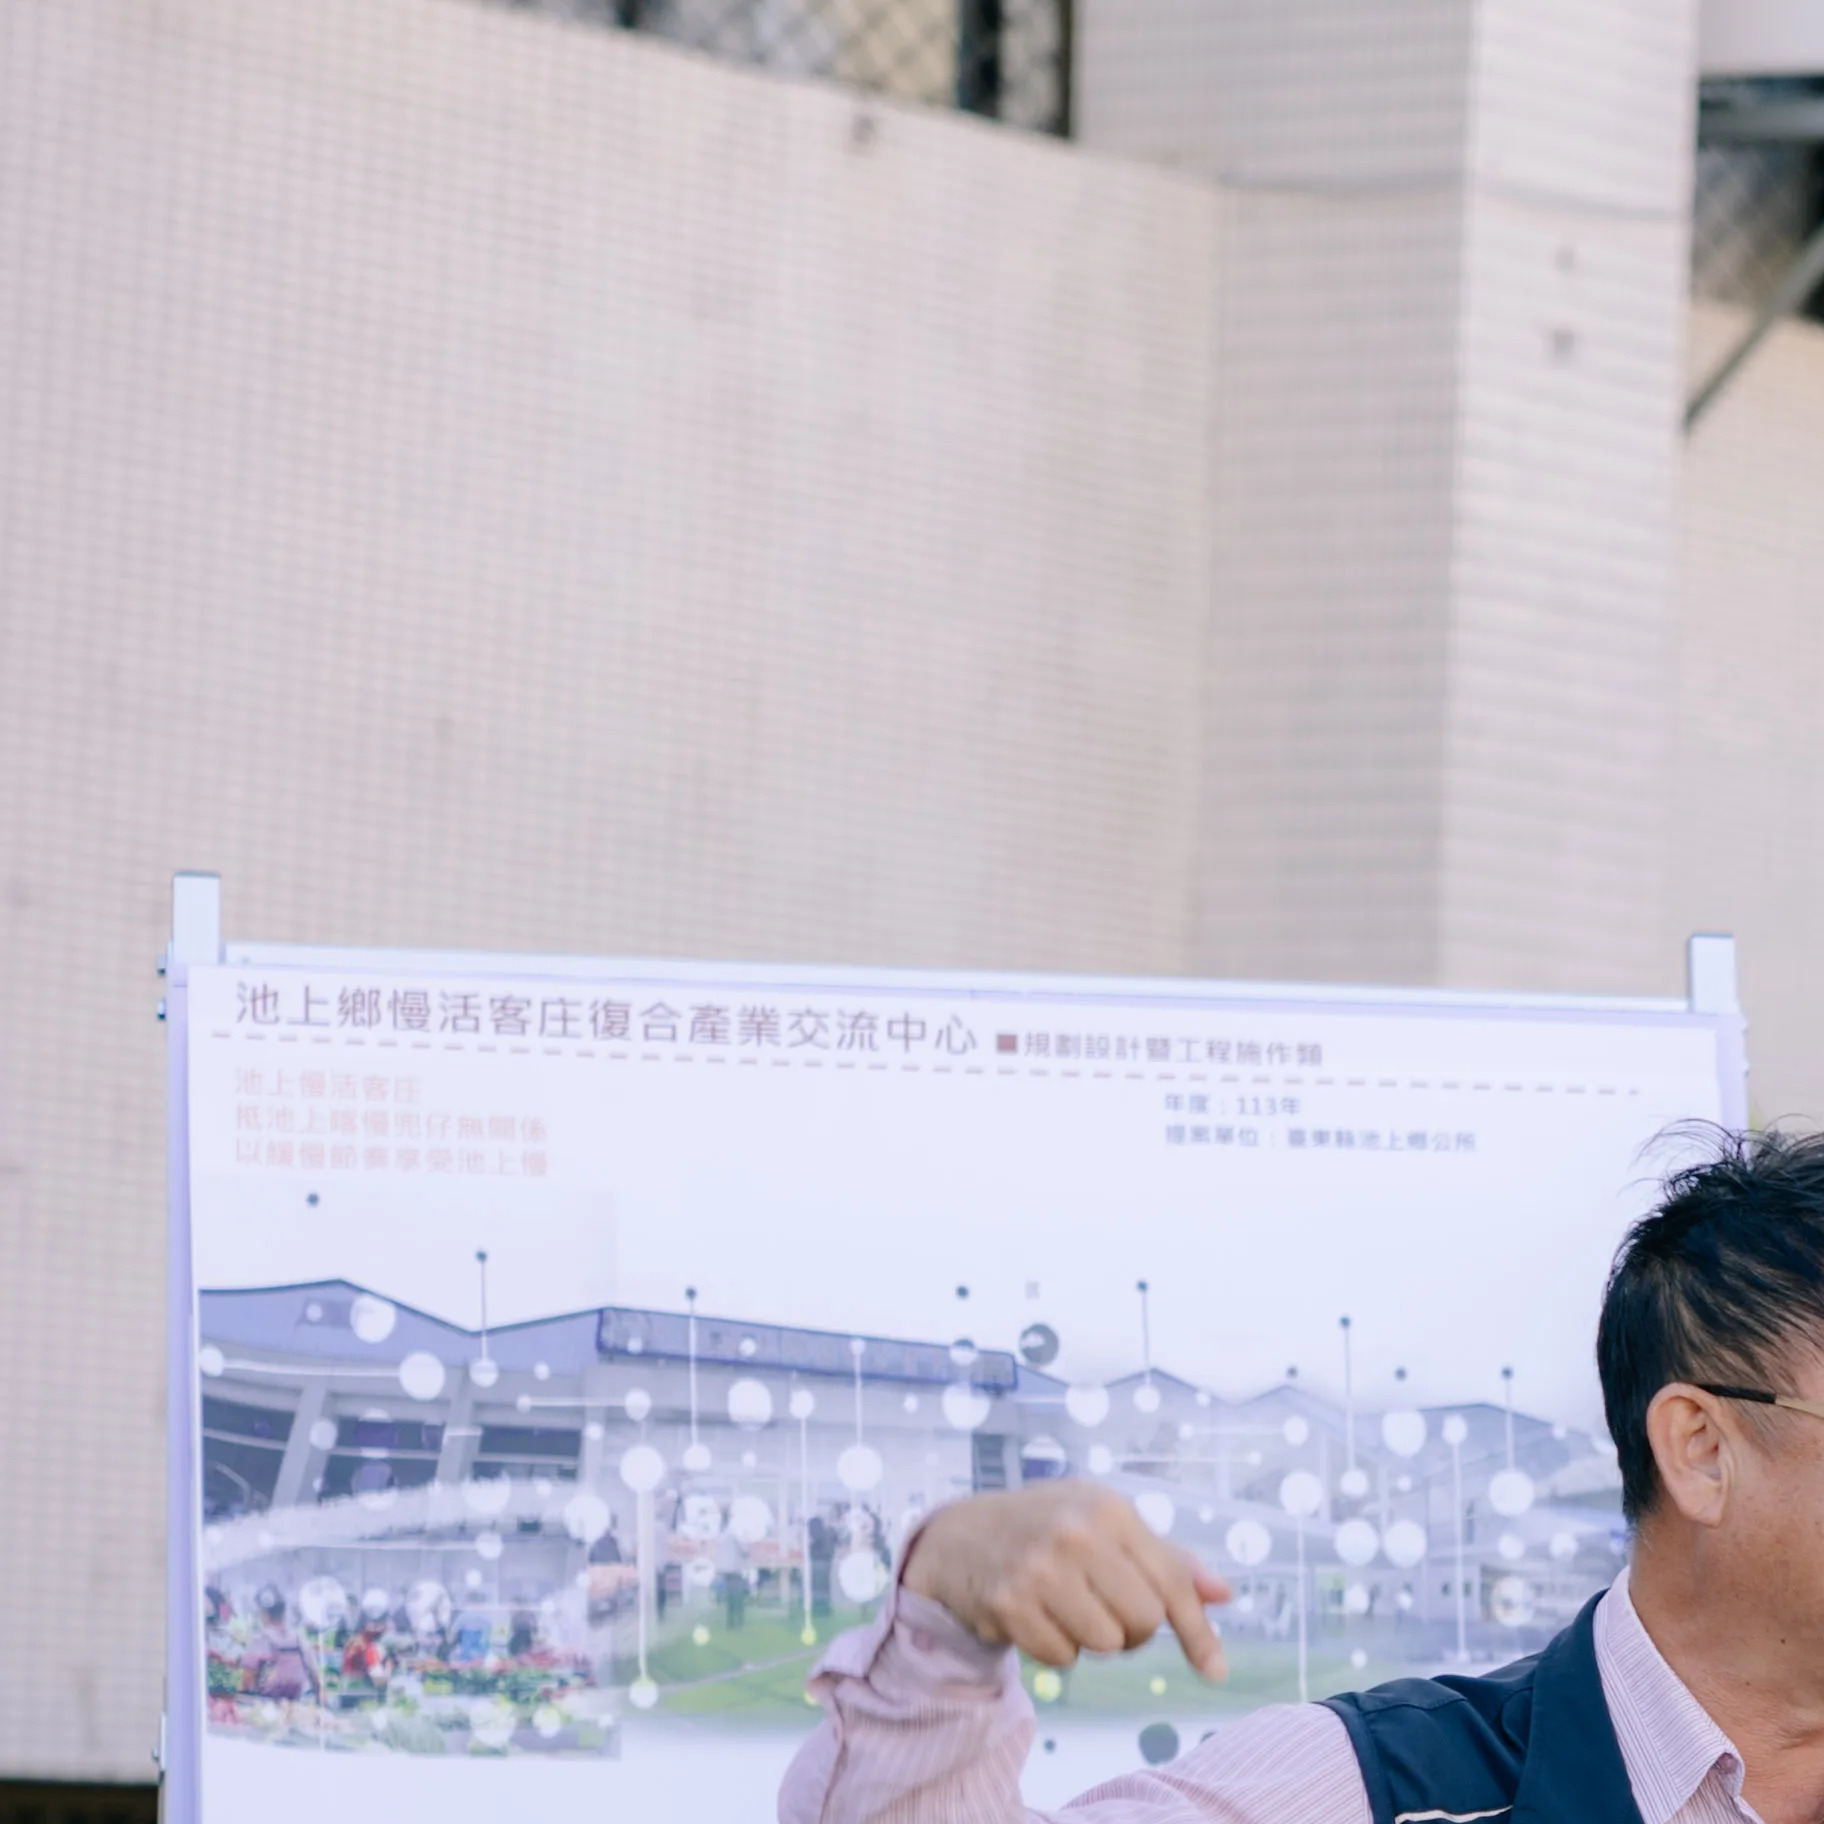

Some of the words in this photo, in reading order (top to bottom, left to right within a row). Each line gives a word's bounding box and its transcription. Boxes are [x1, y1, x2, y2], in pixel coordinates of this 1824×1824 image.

[236, 980, 978, 1055] 池上鄉慢活客庄復合產業交流中心
[1024, 1031, 1323, 1067] 規劃設計暨工程施作類
[235, 1066, 422, 1104] 池上慢活客庄
